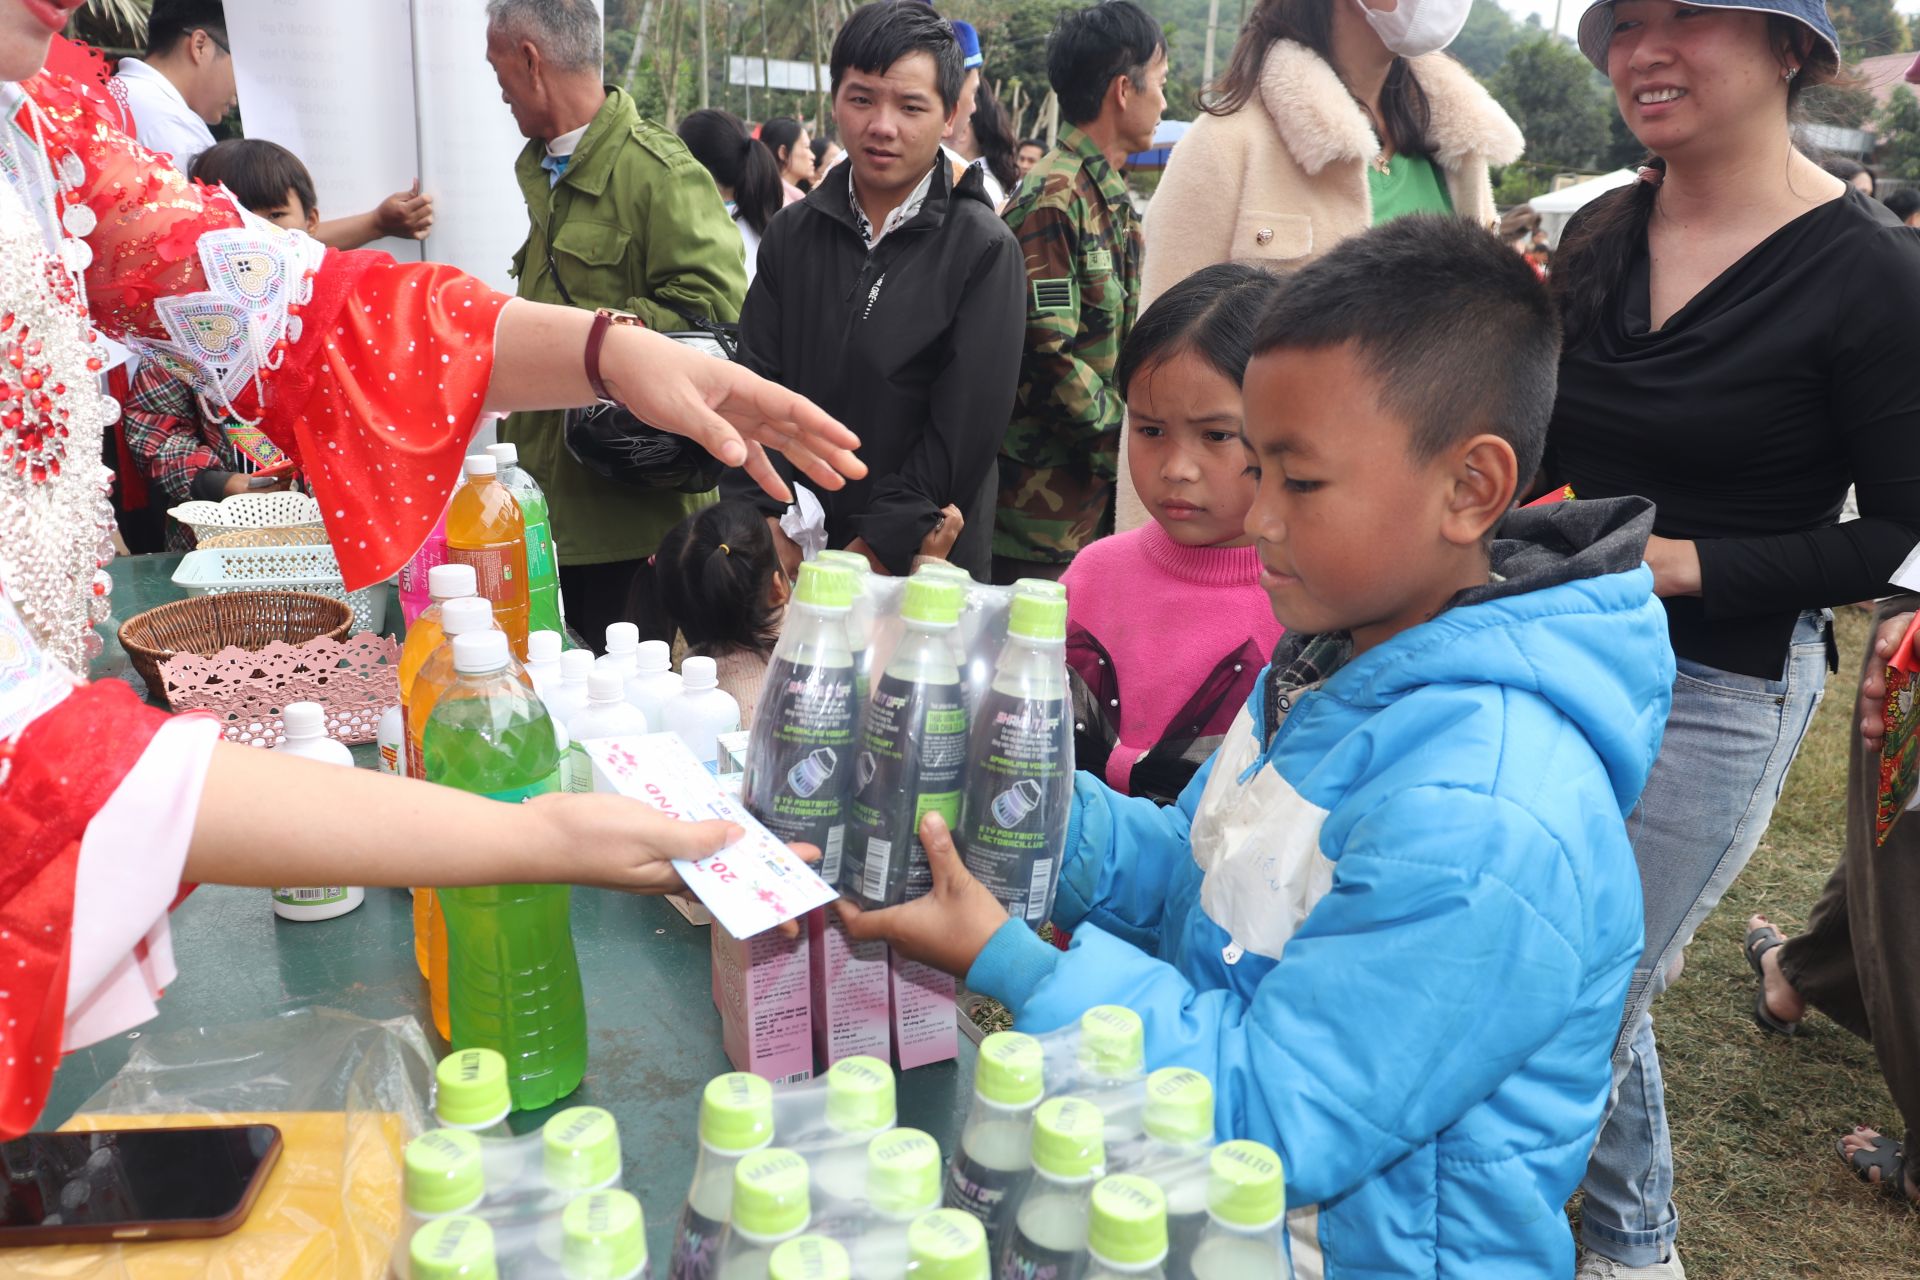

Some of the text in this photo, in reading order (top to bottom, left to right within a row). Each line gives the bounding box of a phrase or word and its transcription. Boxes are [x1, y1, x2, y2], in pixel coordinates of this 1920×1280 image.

[461, 1052, 480, 1081] MALTO
[837, 1062, 883, 1086] MALTO
[1155, 1071, 1201, 1097] MALTO
[559, 1111, 604, 1143] MALTO
[876, 1137, 929, 1161] MALTO
[1222, 1146, 1274, 1174] MALTO
[746, 1156, 801, 1182] MALTO
[1102, 1180, 1157, 1210] MALTO
[433, 1220, 470, 1258] MALTO
